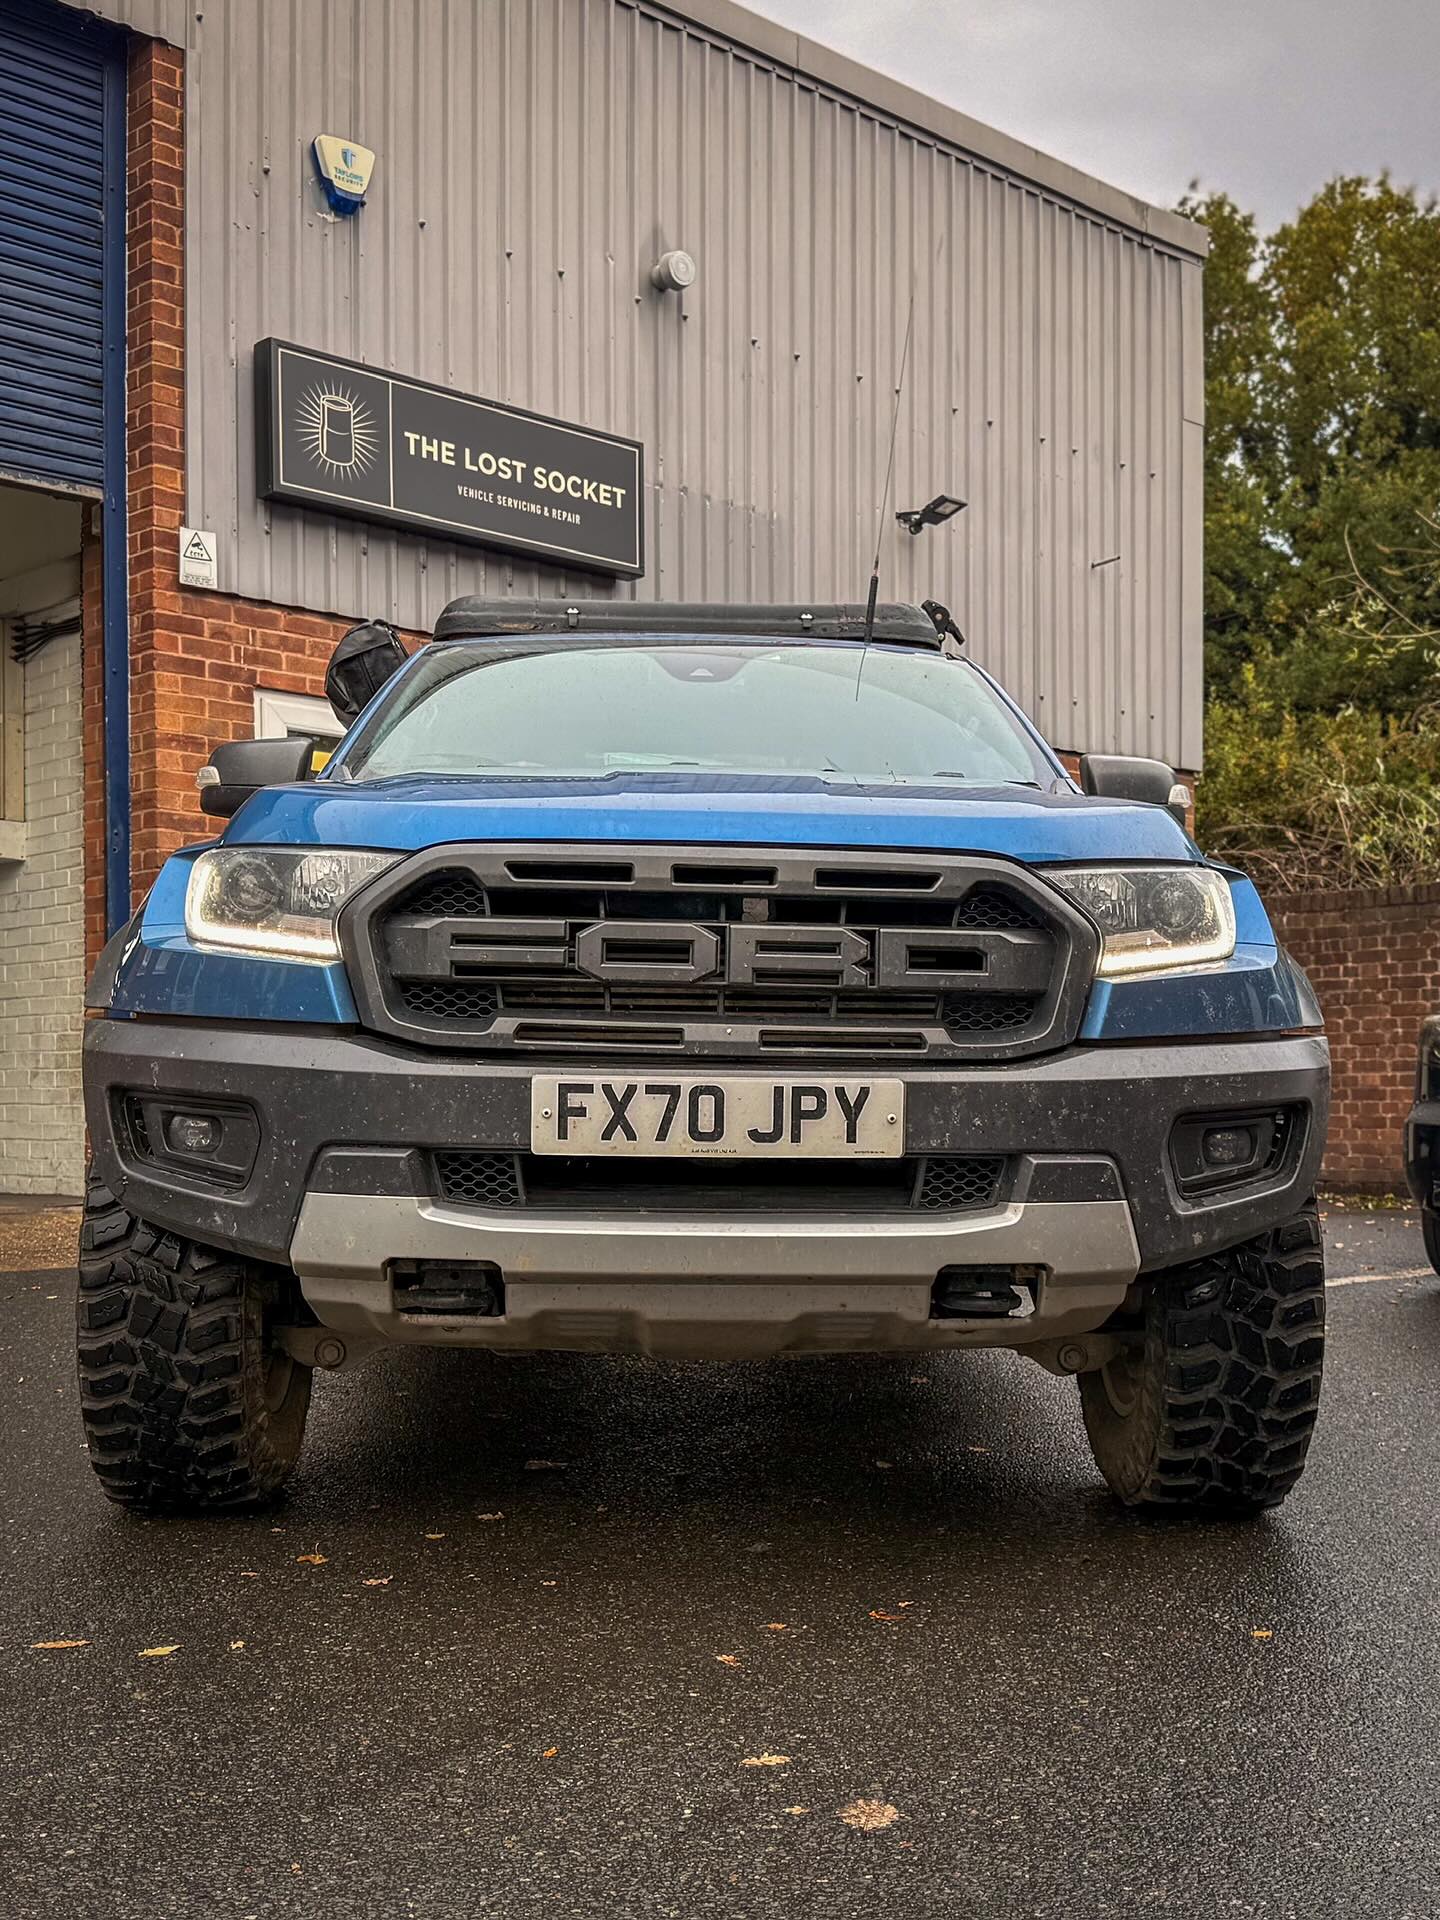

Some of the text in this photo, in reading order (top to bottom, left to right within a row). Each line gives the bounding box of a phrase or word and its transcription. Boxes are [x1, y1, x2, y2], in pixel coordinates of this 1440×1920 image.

[404, 431, 627, 509] THE LOST SOCKET
[457, 484, 582, 525] VEHICLE SERVICING & REPAIR
[427, 916, 1000, 990] FORD
[556, 1082, 872, 1145] FX70 JPY
